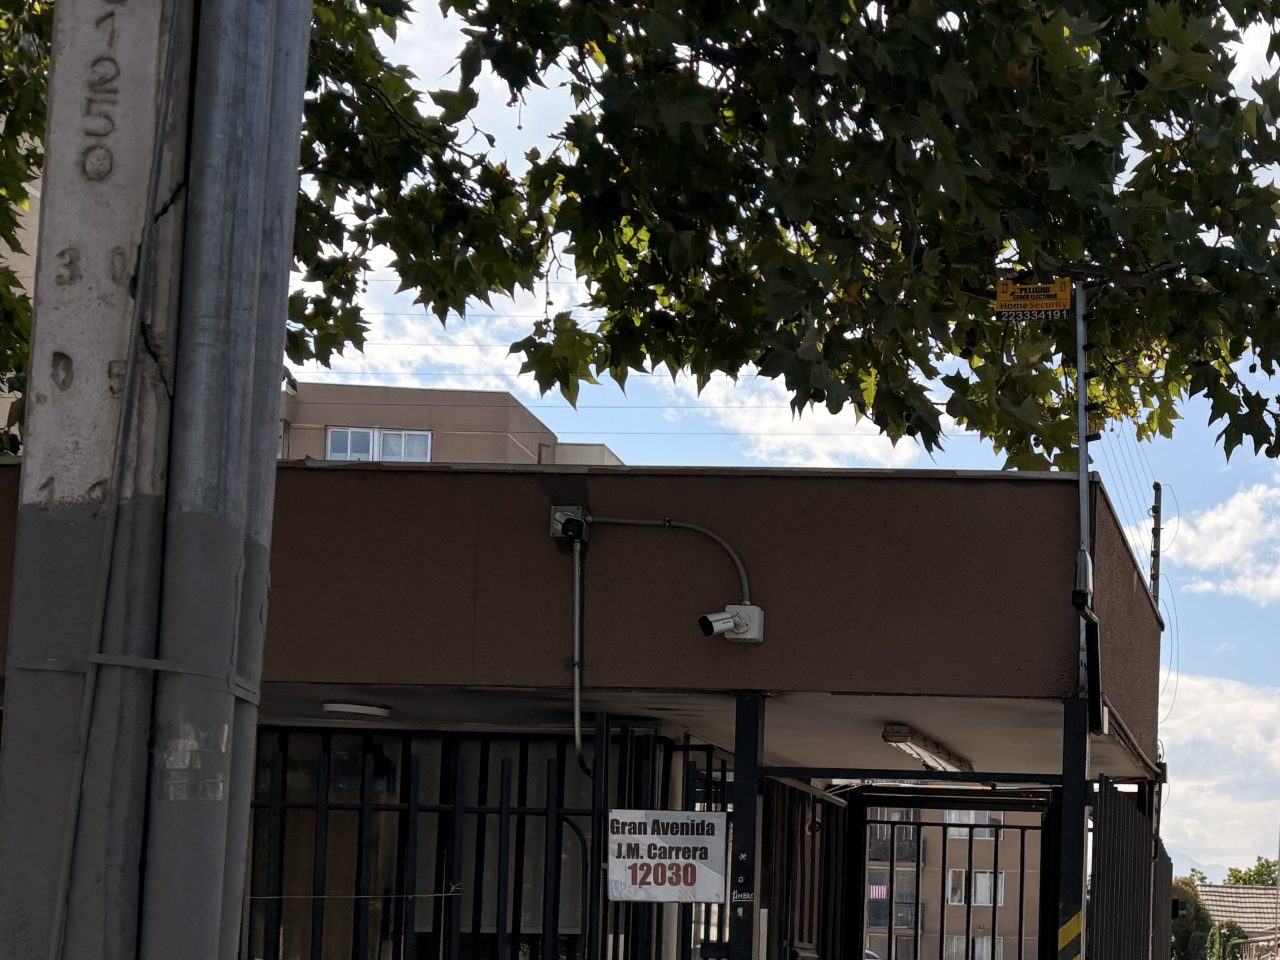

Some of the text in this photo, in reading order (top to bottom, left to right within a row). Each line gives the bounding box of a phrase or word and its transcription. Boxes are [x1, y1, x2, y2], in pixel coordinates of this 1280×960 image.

[1001, 311, 1067, 320] 223334191
[610, 819, 715, 836] Gran Avenida
[616, 843, 709, 860] J.M. Carrera
[628, 862, 697, 887] 12030
